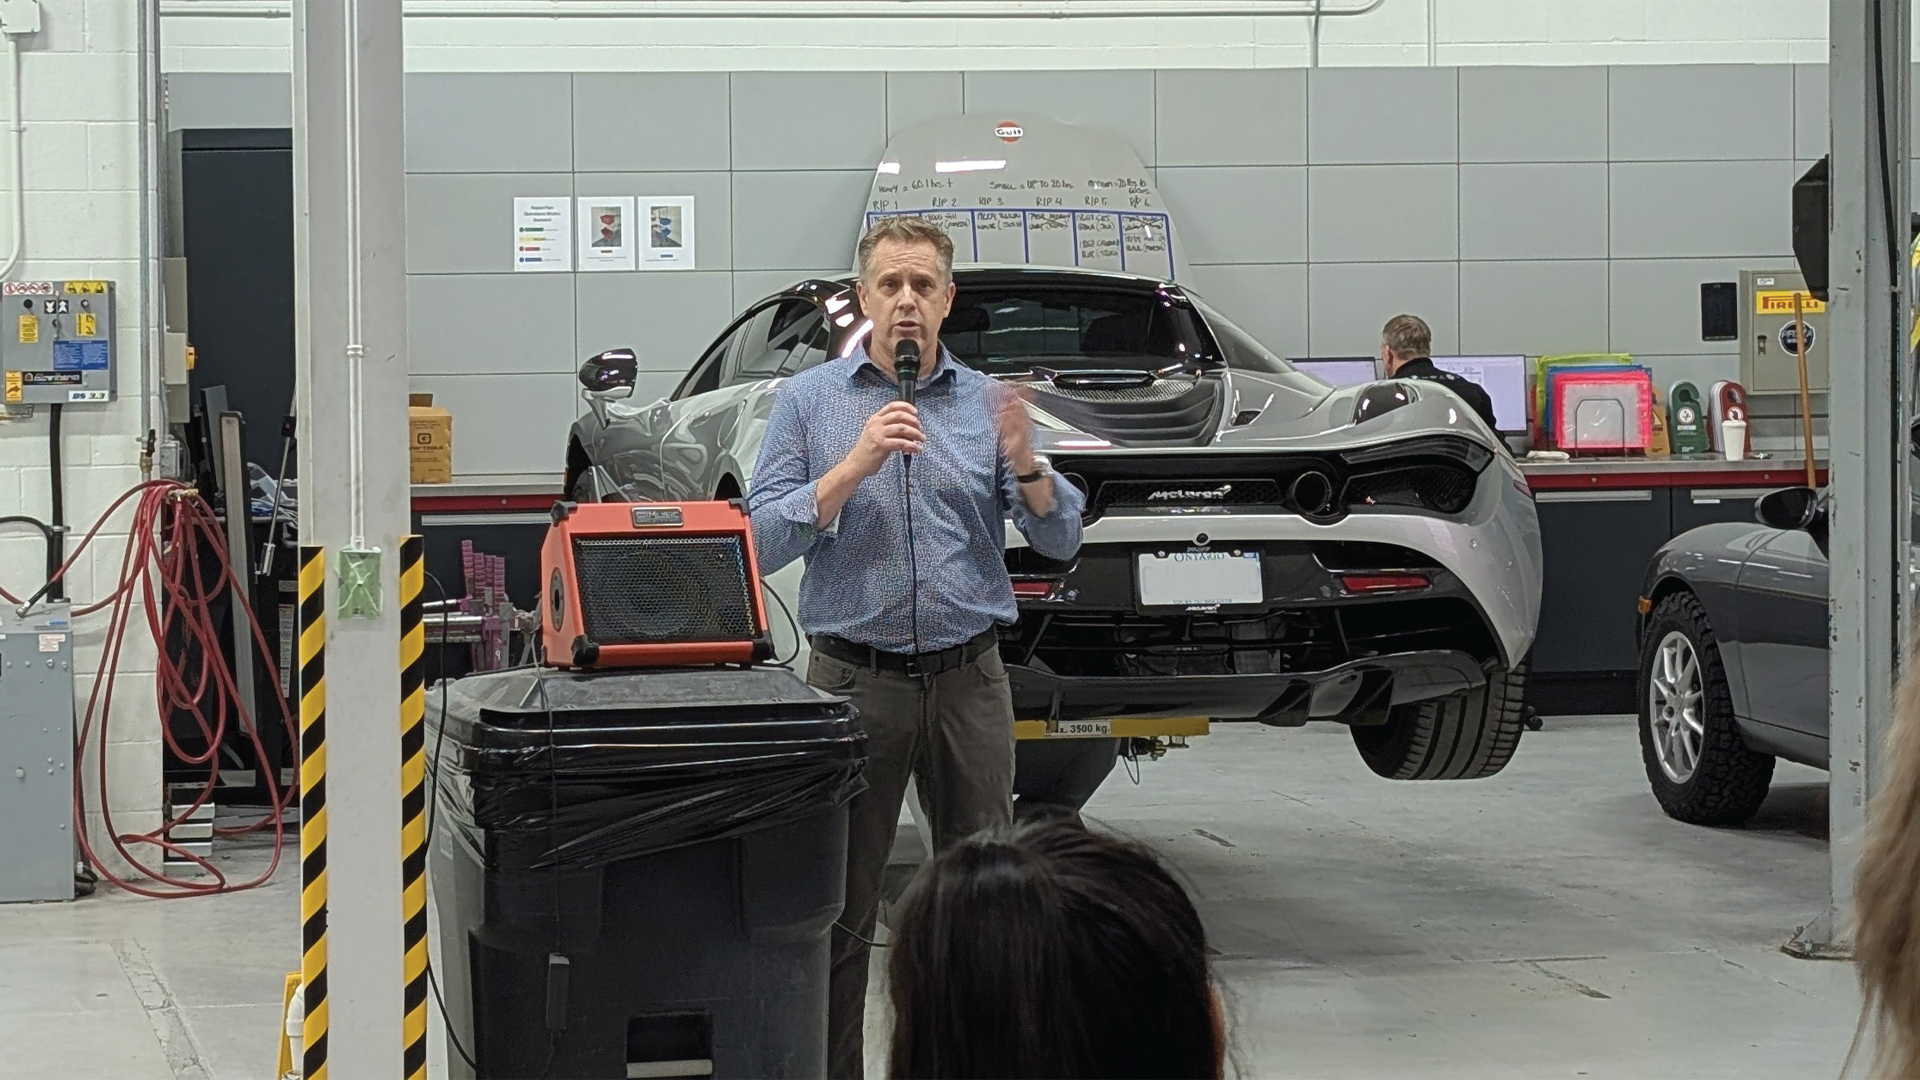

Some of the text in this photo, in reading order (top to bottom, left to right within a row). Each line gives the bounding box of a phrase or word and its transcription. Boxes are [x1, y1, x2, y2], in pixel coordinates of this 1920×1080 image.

[997, 197, 1004, 206] 3
[1055, 197, 1062, 206] 4
[1762, 295, 1819, 309] PIRELI
[1147, 487, 1227, 501] McLaren
[1174, 552, 1225, 562] ONTARIO
[1070, 724, 1093, 733] 3500
